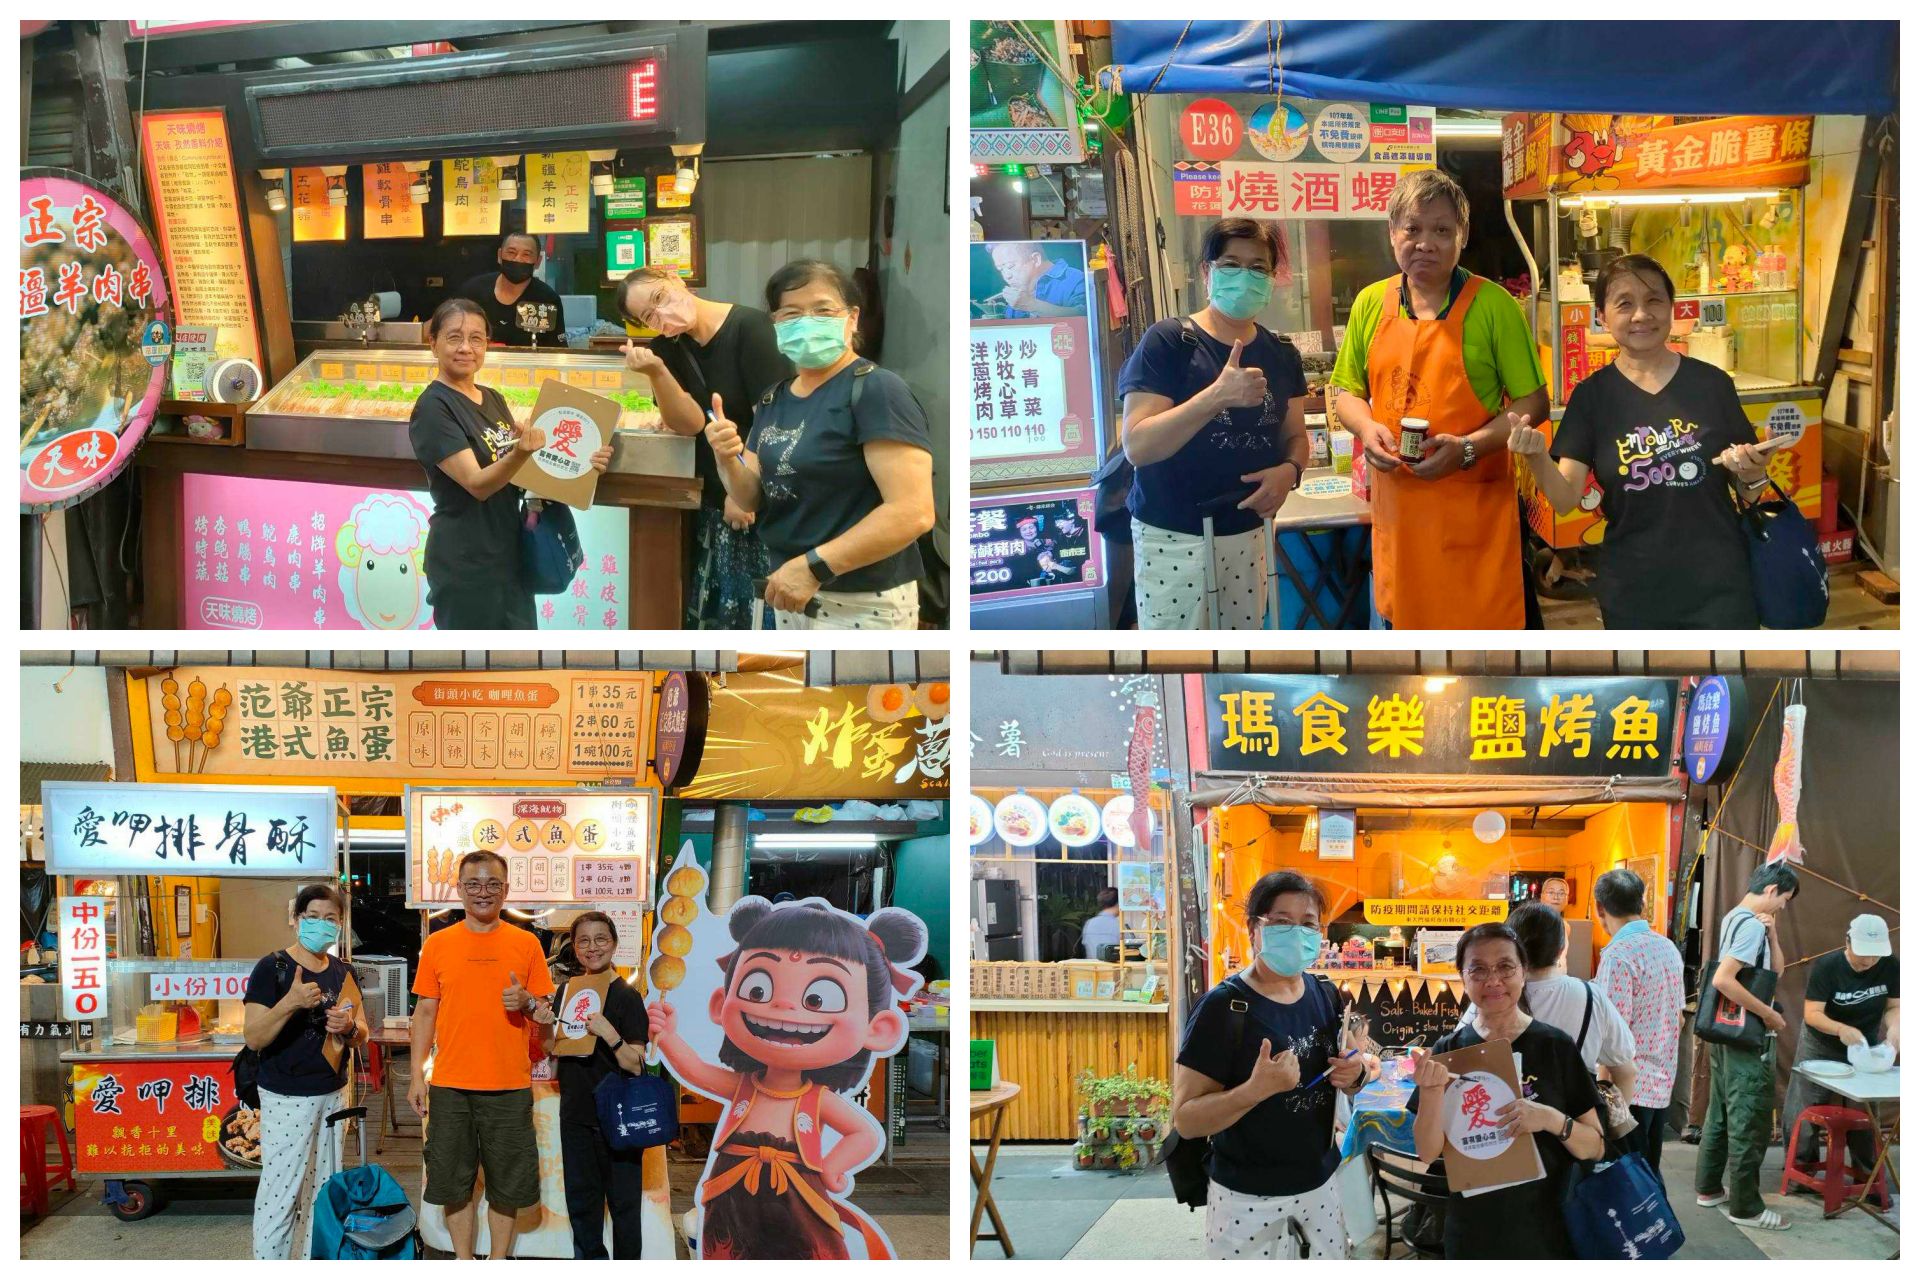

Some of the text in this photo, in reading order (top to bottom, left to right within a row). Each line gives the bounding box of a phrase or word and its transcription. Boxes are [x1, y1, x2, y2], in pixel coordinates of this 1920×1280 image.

[1190, 112, 1234, 146] E36
[1635, 119, 1811, 178] 黃金脆薯條
[453, 158, 470, 207] 鴕鳥肉
[1180, 172, 1207, 180] Please
[1226, 169, 1398, 213] 燒酒螺
[564, 185, 579, 213] 正宗
[24, 199, 107, 252] 正宗
[1569, 308, 1584, 323] 小
[1679, 303, 1694, 317] 大
[1703, 304, 1723, 322] 100
[1019, 339, 1042, 417] 炒青菜
[976, 426, 998, 440] 150
[1000, 424, 1022, 438] 110
[43, 431, 107, 486] 天味
[1623, 458, 1676, 492] 500
[194, 515, 209, 581] 烤時蔬
[214, 515, 229, 582] 杏鮑菇
[287, 523, 302, 595] 鹿肉串
[310, 510, 327, 630] 招牌羊肉串
[205, 601, 258, 626] 天味燒烤
[239, 680, 395, 722] 范爺正宗
[433, 687, 539, 702] 街頭小吃 咖哩魚蛋
[239, 723, 396, 763] 港式魚蛋
[414, 719, 431, 760] 原味
[446, 719, 463, 760] 麻辣
[478, 720, 493, 761] 芥末
[508, 722, 525, 760] 胡椒
[539, 722, 556, 763] 檸檬
[1218, 690, 1660, 761] 瑪食樂 鹽烤魚
[73, 805, 317, 867] 愛呷排骨酥
[479, 823, 600, 846] 港式魚蛋
[1370, 903, 1502, 916] 防疫期間請保持社交距離
[1412, 1002, 1439, 1016] Baked
[86, 1143, 206, 1159] 難以抗拒的美味
[111, 1125, 179, 1140] 飄香十里
